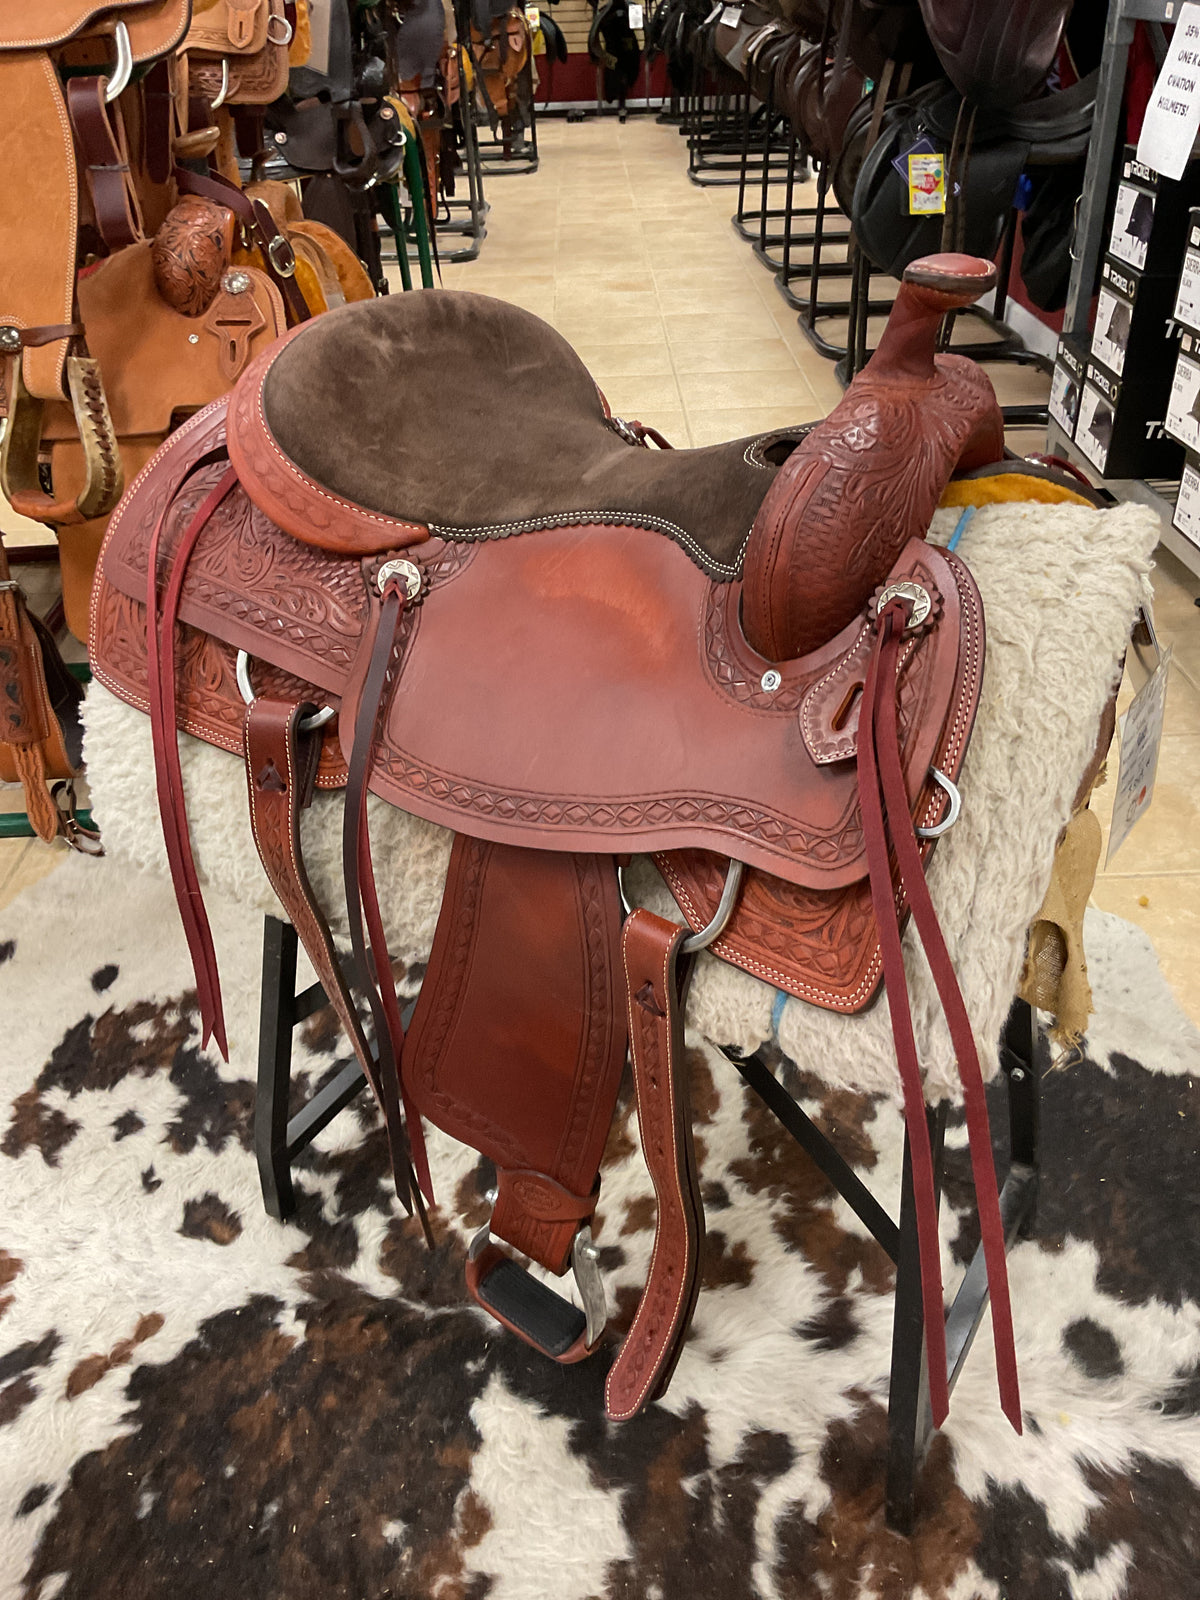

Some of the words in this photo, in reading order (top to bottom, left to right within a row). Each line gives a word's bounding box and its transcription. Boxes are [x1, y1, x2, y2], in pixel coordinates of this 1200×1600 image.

[1178, 50, 1193, 64] ONE
[1167, 74, 1196, 93] OVATION
[1157, 96, 1190, 117] HELMETS!
